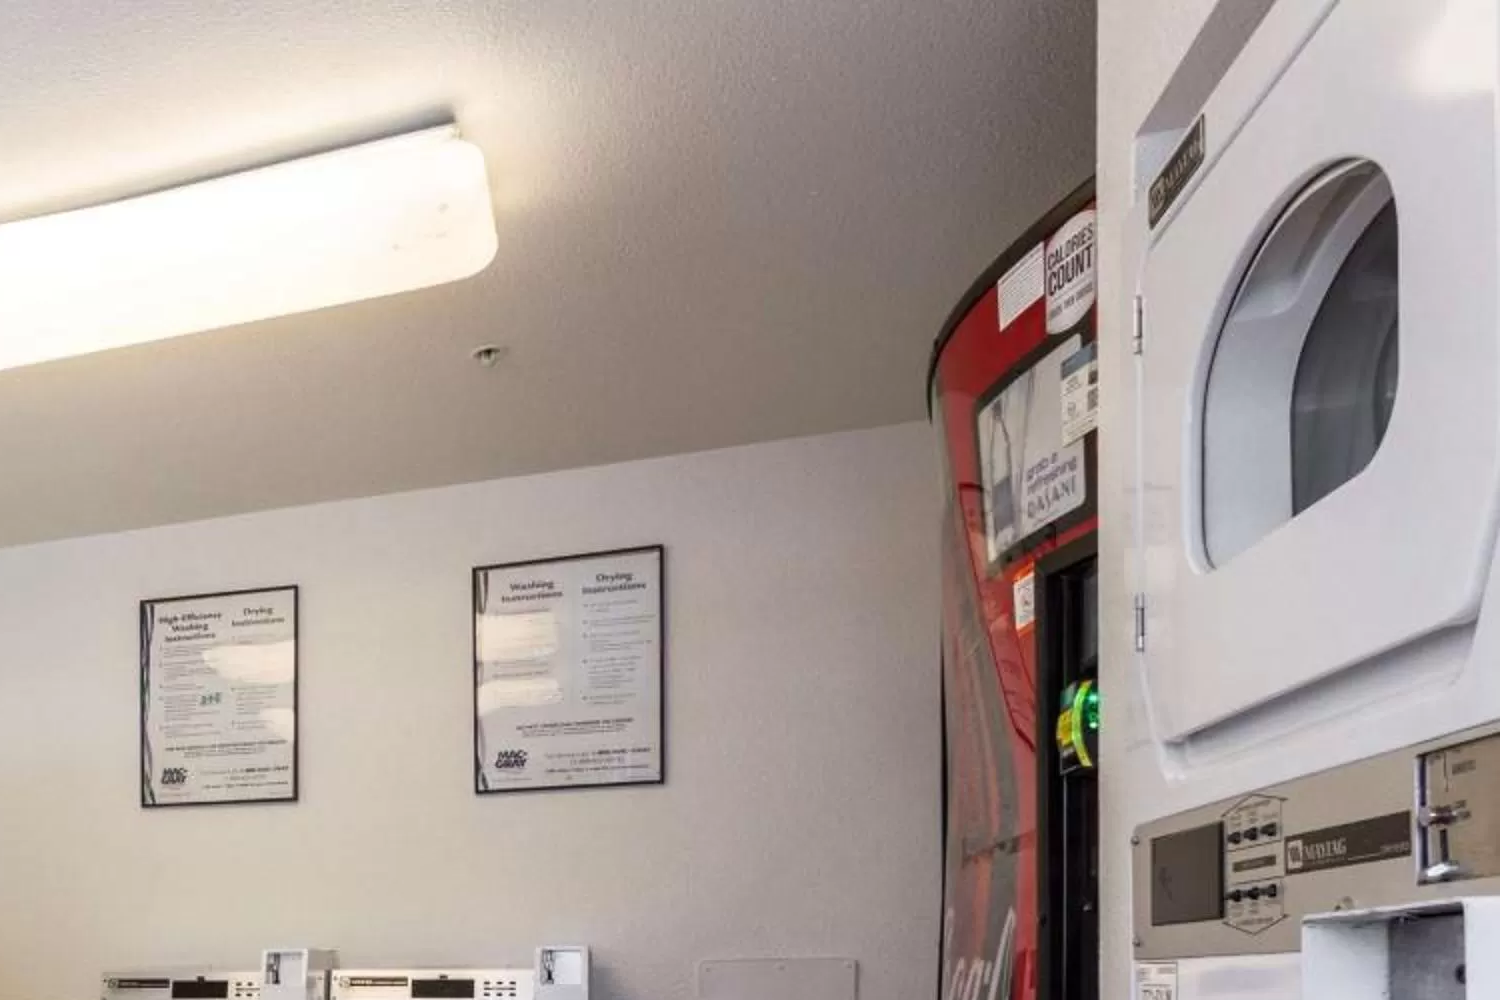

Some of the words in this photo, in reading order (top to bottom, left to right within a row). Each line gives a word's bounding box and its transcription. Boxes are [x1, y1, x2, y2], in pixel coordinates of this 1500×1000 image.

[1047, 222, 1093, 271] CALORIES
[1047, 243, 1093, 297] COUNT
[1026, 475, 1077, 519] DASANI
[595, 572, 635, 583] Drying
